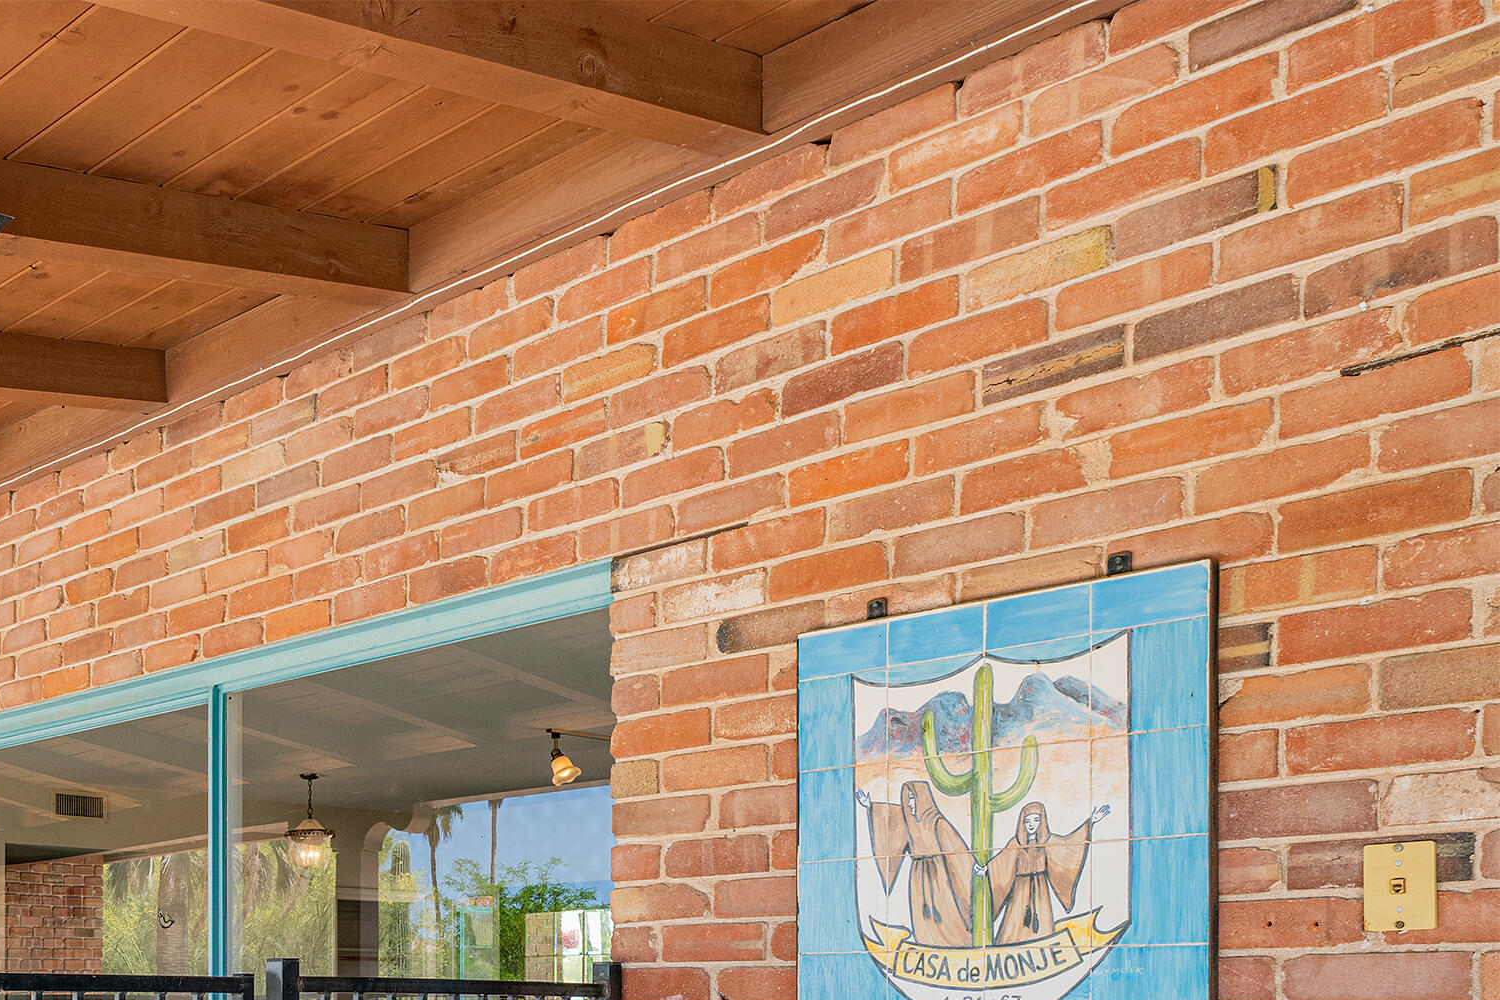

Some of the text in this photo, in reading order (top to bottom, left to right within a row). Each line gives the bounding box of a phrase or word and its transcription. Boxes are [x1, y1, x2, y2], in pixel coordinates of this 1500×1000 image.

[903, 942, 1067, 983] CASA de MONJE
